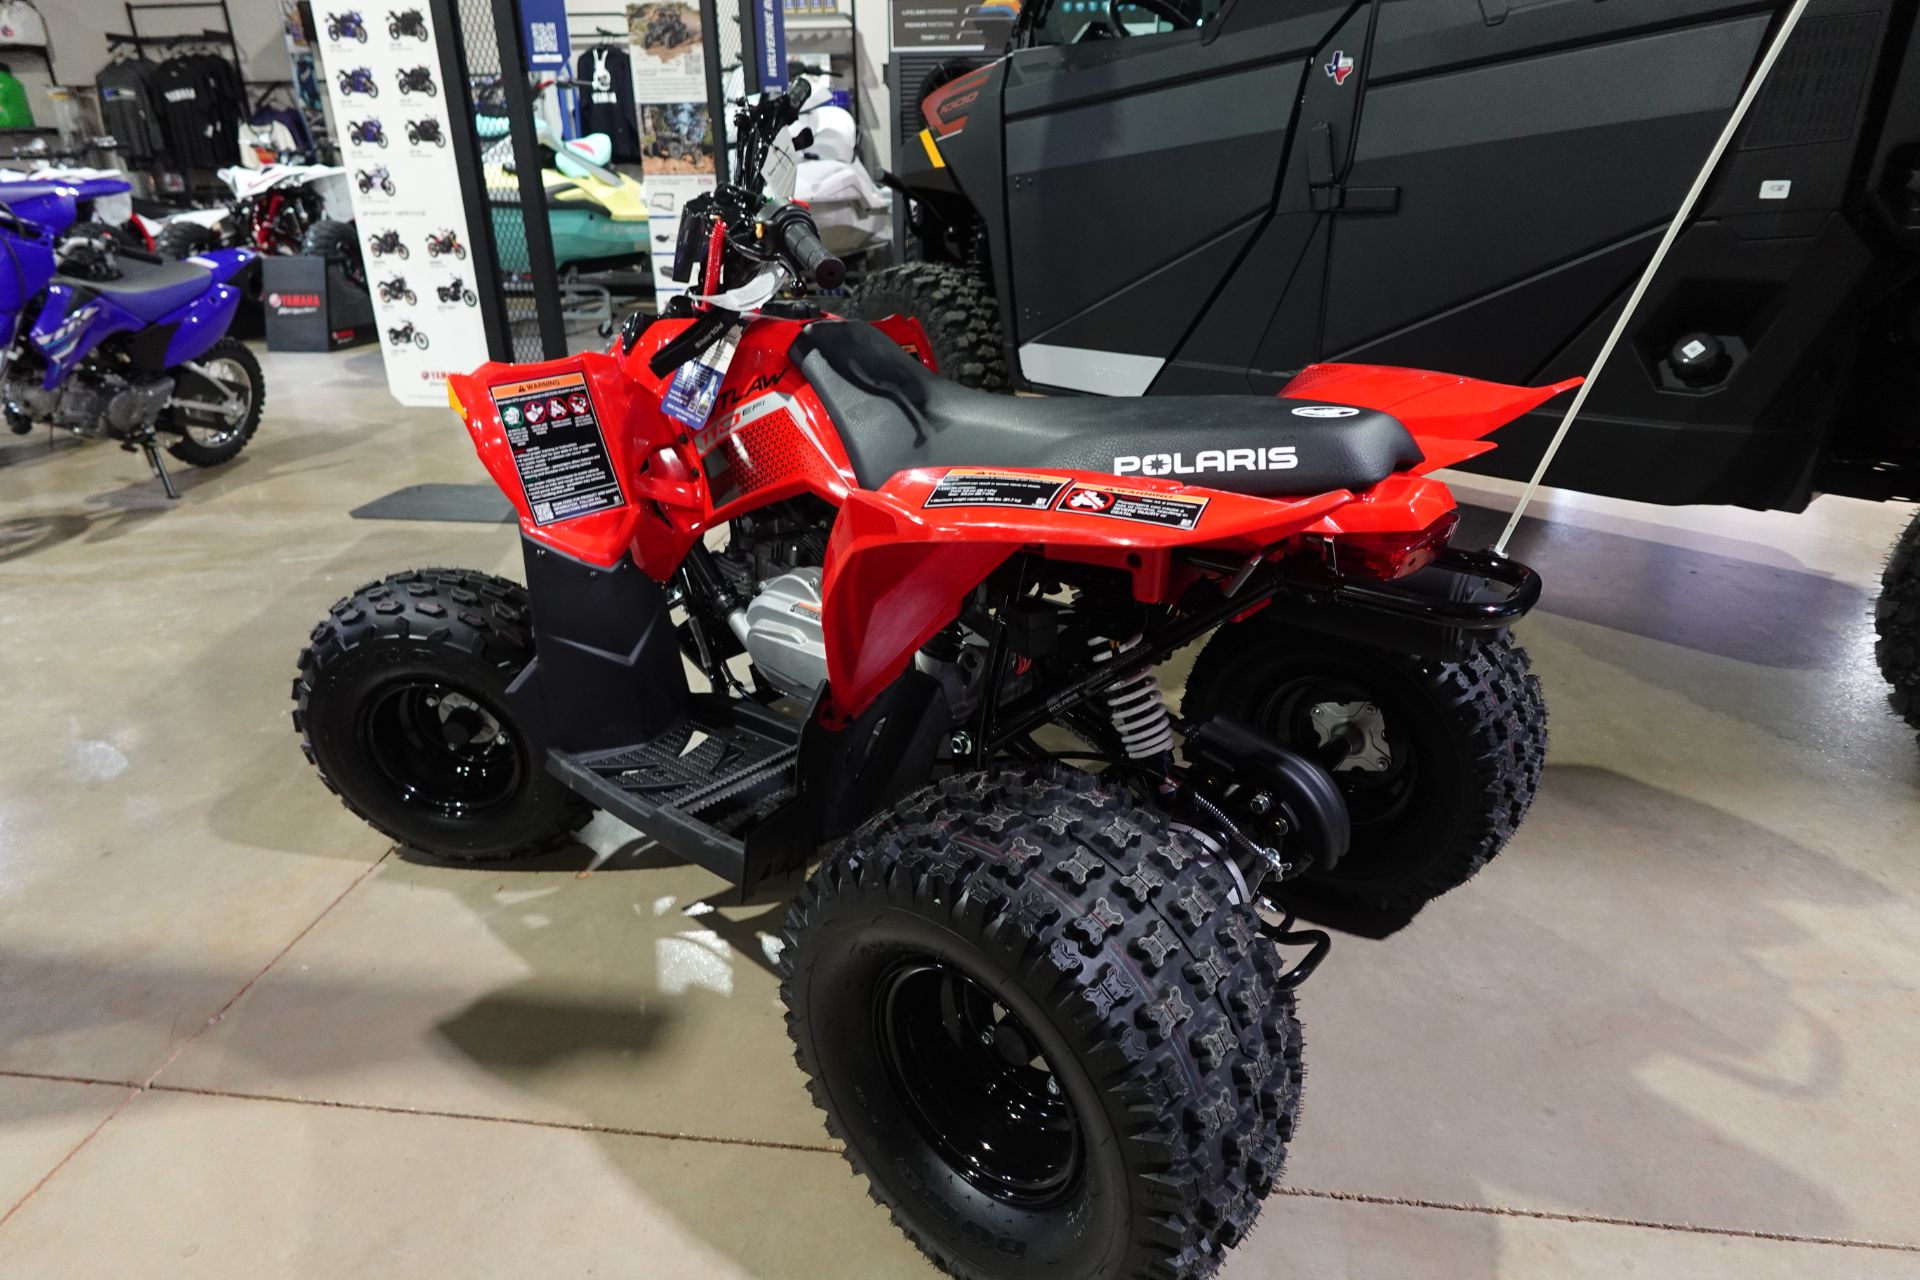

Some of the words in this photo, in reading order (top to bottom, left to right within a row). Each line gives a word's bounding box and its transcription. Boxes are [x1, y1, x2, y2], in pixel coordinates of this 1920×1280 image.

[763, 10, 778, 77] WOLVERINE
[940, 91, 979, 114] 1000
[281, 294, 320, 307] YAMAHA
[527, 379, 560, 391] WARNING
[719, 367, 788, 410] TLAW
[742, 400, 766, 416] EFI
[1113, 446, 1298, 476] POLARIS
